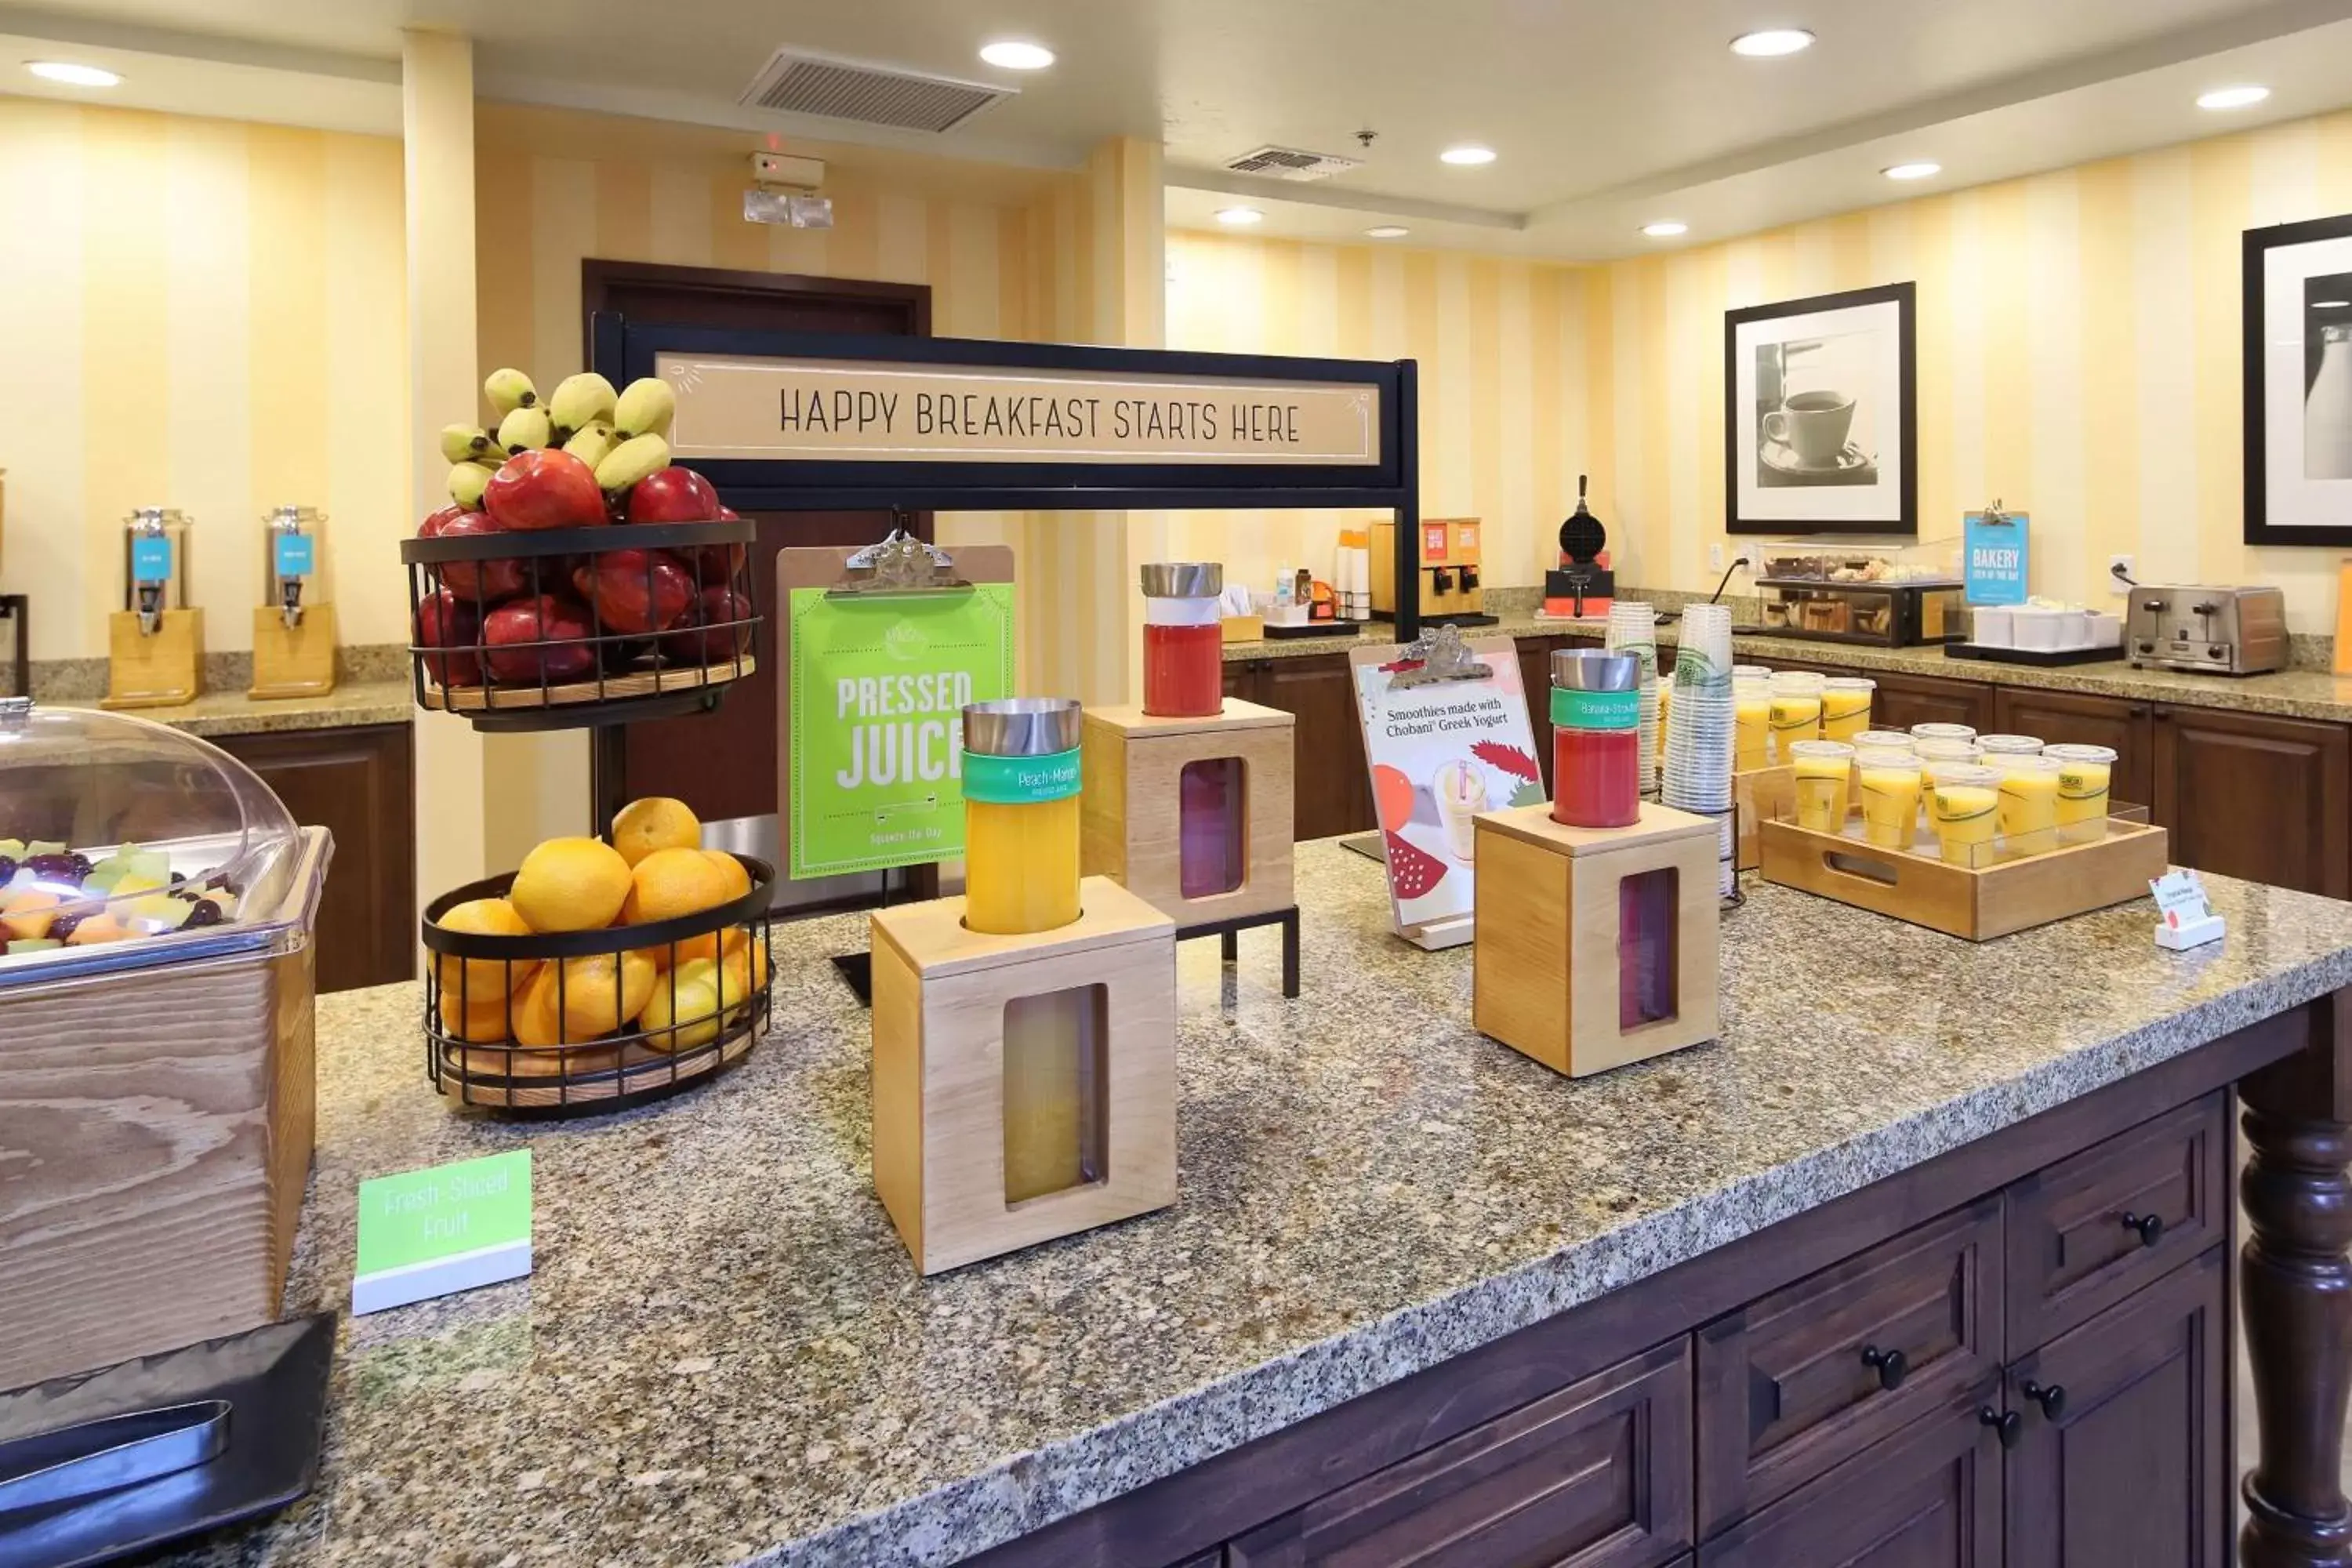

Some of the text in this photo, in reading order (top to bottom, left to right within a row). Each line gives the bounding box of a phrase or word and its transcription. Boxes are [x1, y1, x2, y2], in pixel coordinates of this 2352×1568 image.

[780, 388, 1300, 442] HAPPY BREAKFAST STARTS HERE
[1973, 548, 2020, 568] BAKERY
[837, 671, 971, 720] PRESSED
[1387, 697, 1502, 722] Smoothies made with
[1439, 717, 1473, 731] Greek
[1473, 712, 1508, 728] Yogurt
[384, 1185, 440, 1216] Fresh
[423, 1211, 470, 1243] Fruit
